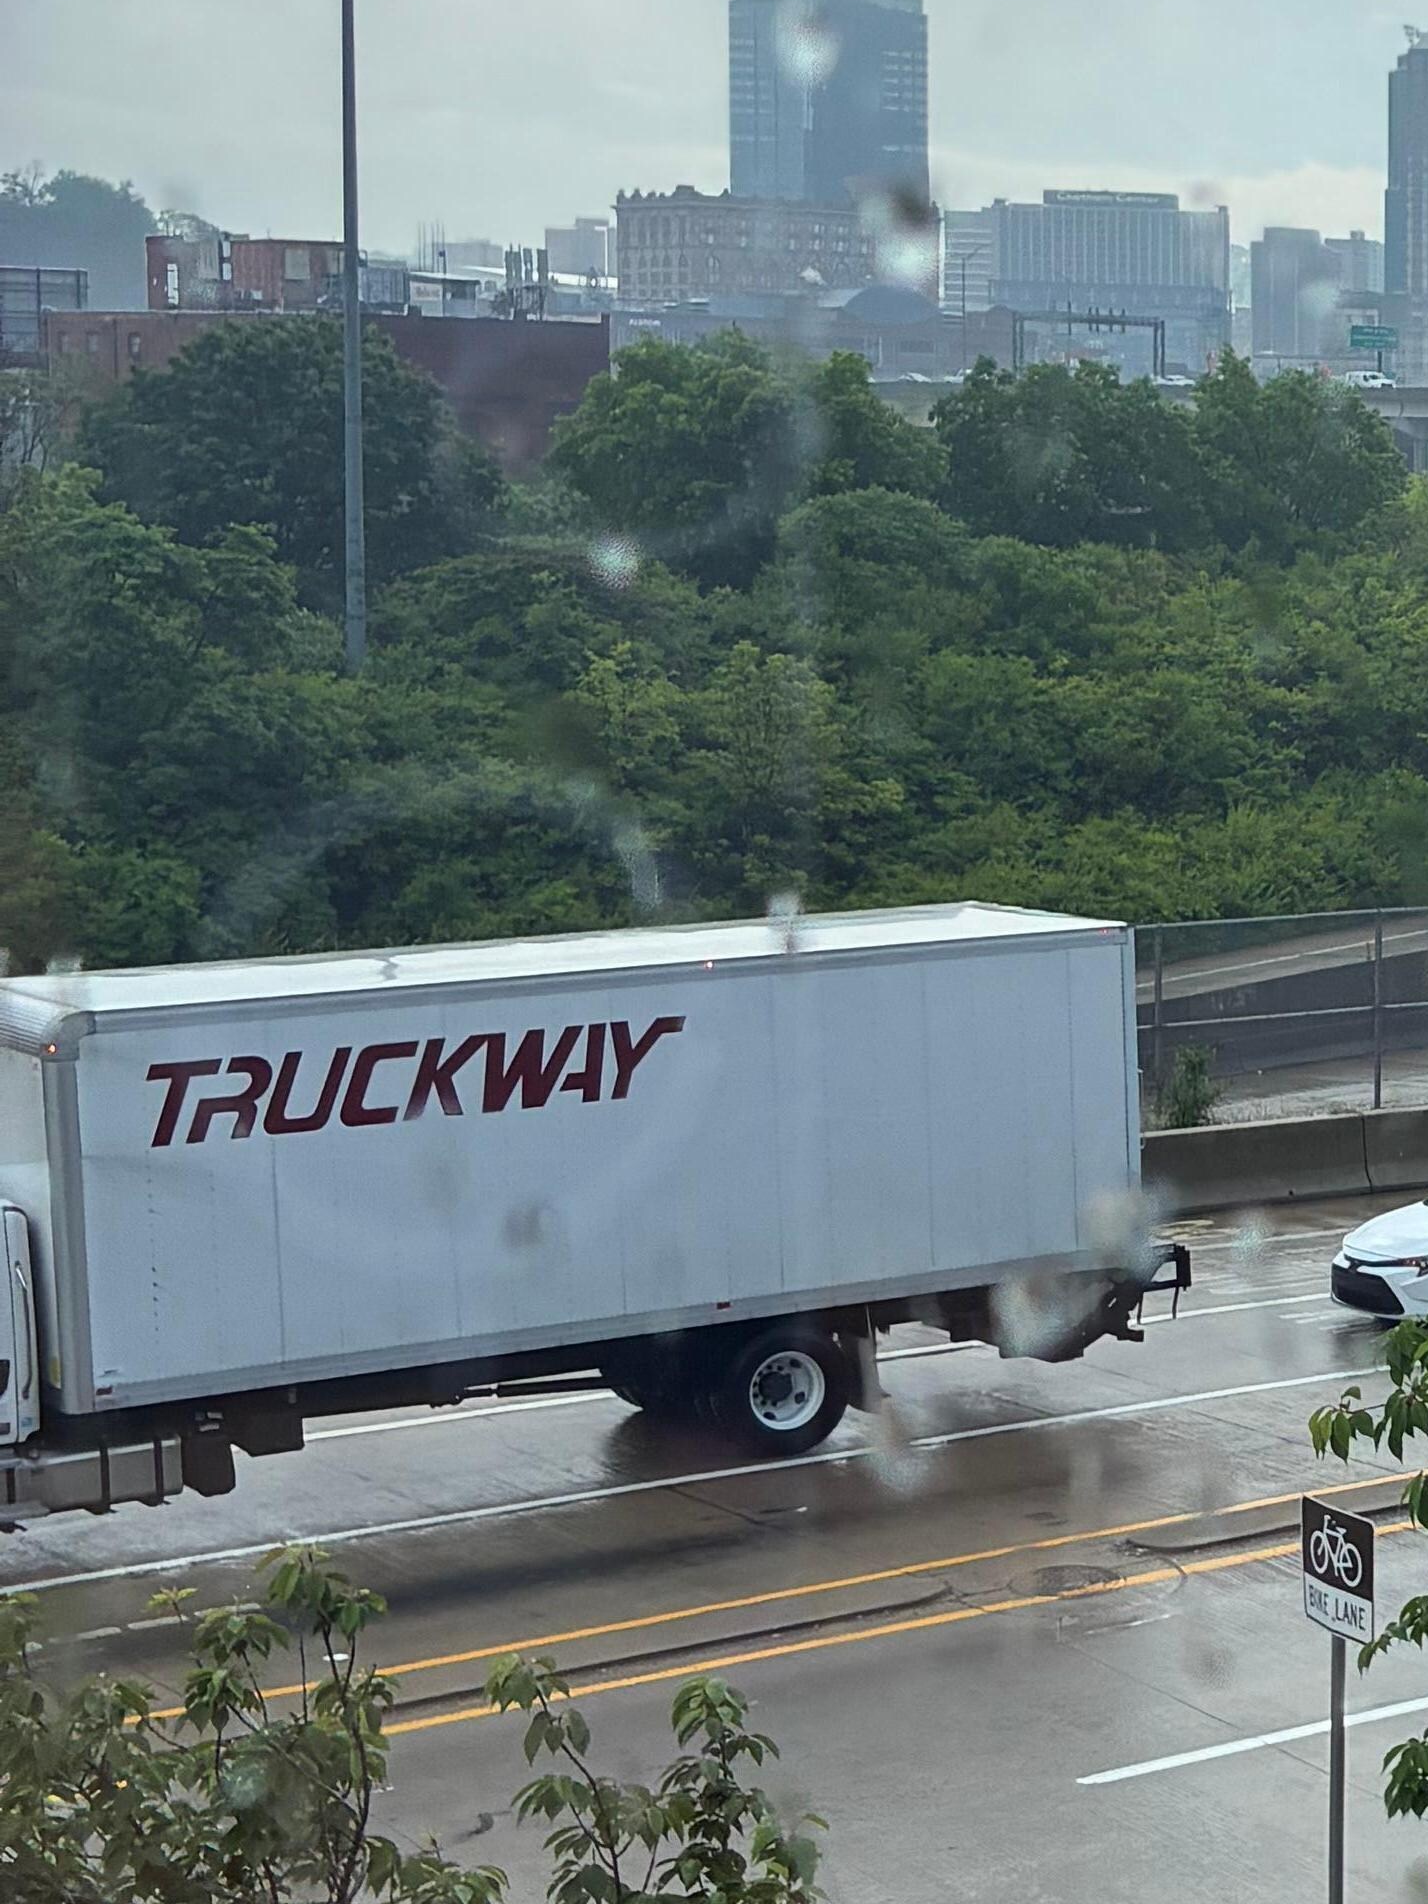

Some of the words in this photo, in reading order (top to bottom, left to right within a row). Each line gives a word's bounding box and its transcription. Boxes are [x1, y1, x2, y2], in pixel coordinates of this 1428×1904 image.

[146, 1016, 687, 1148] TRUCKWAY
[1309, 1584, 1329, 1616] BIKE
[1335, 1597, 1366, 1632] LANE
